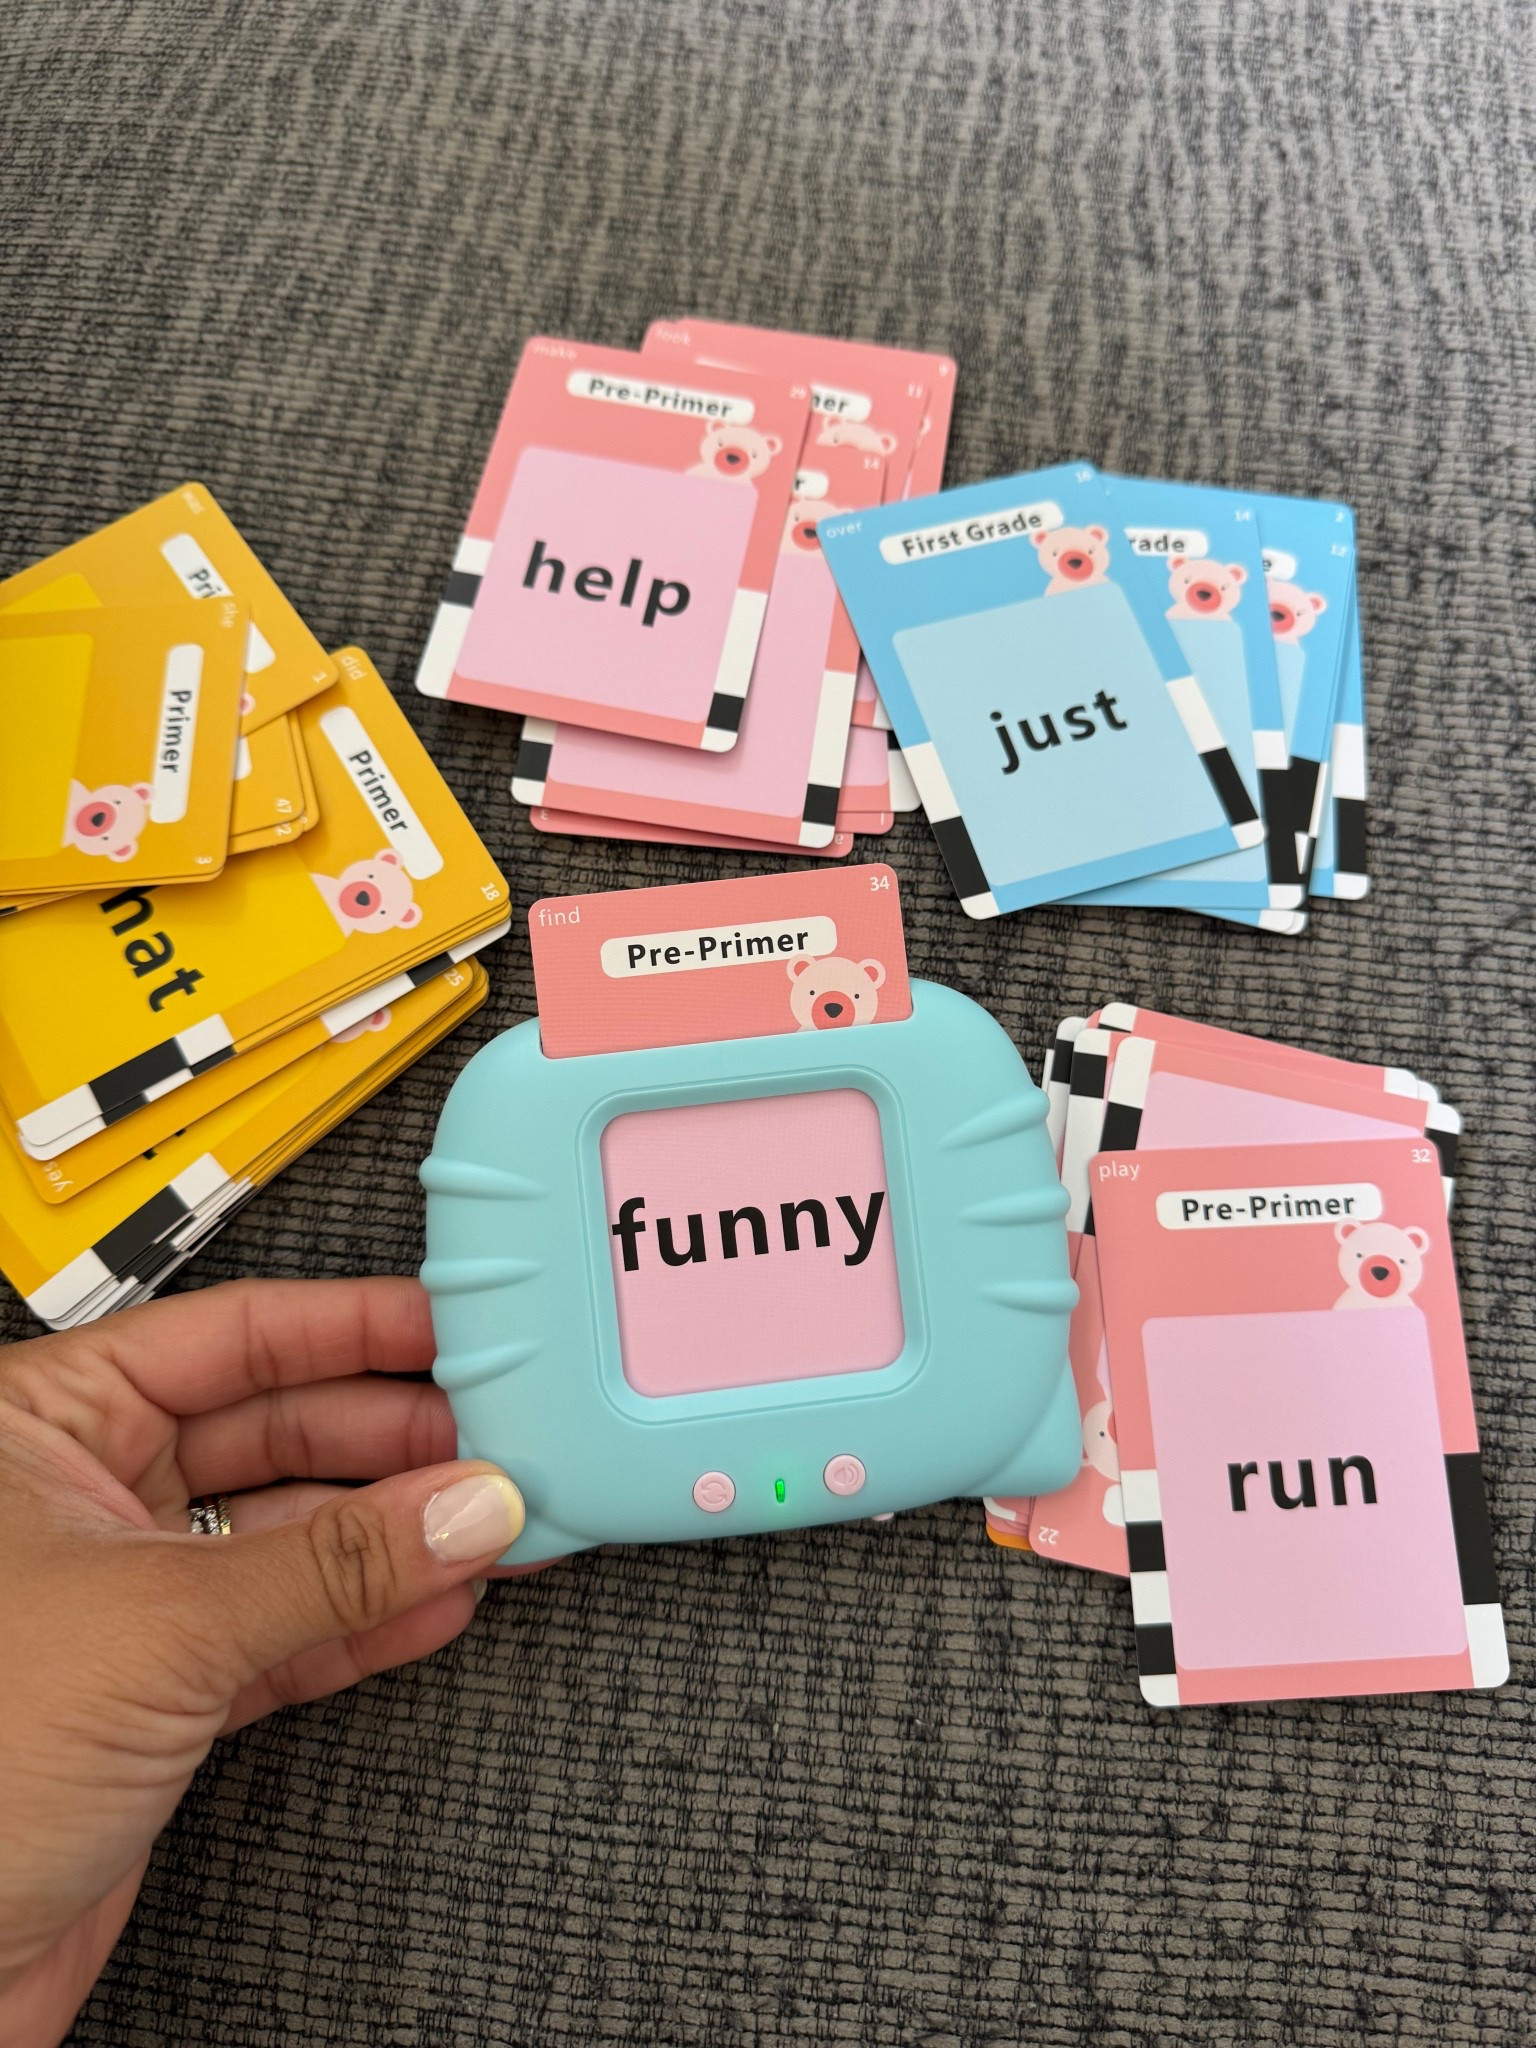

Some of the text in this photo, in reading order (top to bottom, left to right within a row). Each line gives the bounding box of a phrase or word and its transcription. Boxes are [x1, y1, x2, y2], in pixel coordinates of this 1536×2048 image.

[588, 378, 733, 418] Pre-Primer
[826, 521, 863, 539] over
[901, 511, 1043, 557] First Grade
[522, 540, 691, 628] help
[339, 655, 367, 681] did
[160, 690, 193, 774] Primer
[990, 690, 1128, 775] just
[349, 749, 408, 832] Primer
[481, 882, 500, 901] 18
[869, 875, 891, 892] 34
[538, 906, 581, 927] find
[100, 885, 205, 1013] hat
[627, 931, 809, 969] Pre-Primer
[444, 968, 465, 987] 25
[1099, 1160, 1141, 1182] play
[1411, 1148, 1432, 1163] 32
[43, 1160, 74, 1194] yes
[1181, 1193, 1355, 1222] Pre-Primer
[612, 1191, 886, 1272] funny
[1227, 1455, 1378, 1512] run
[1038, 1526, 1060, 1545] 22
